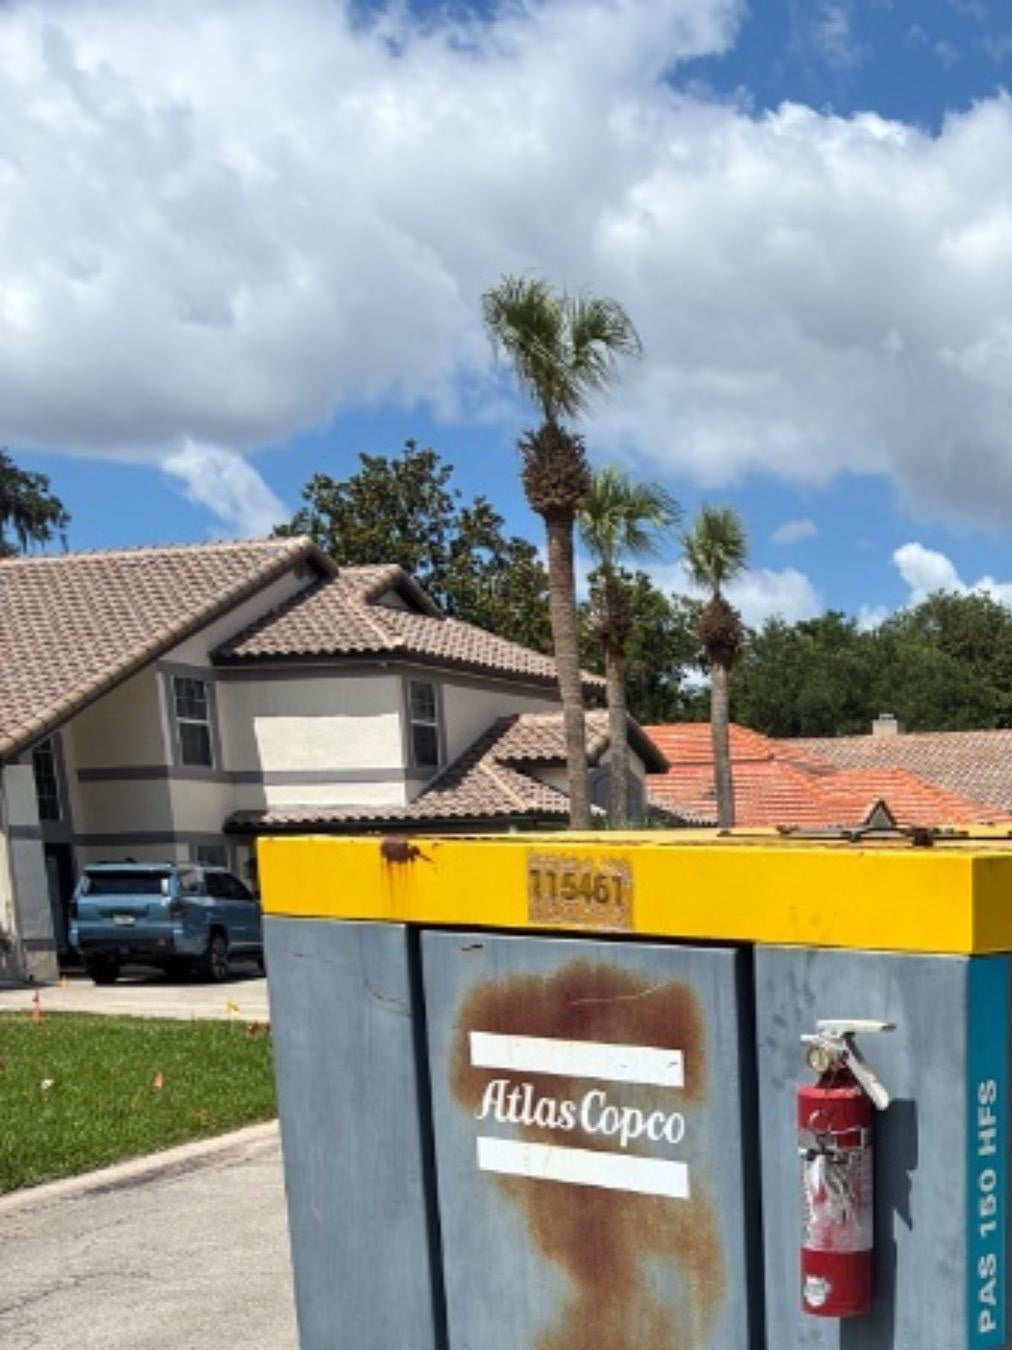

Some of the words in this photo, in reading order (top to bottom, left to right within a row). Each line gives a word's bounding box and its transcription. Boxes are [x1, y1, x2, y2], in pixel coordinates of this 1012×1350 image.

[529, 868, 623, 907] 115461
[475, 1078, 577, 1132] Atlas
[580, 1088, 685, 1148] Copco
[977, 1079, 998, 1157] HFS
[977, 1253, 998, 1334] PAS
